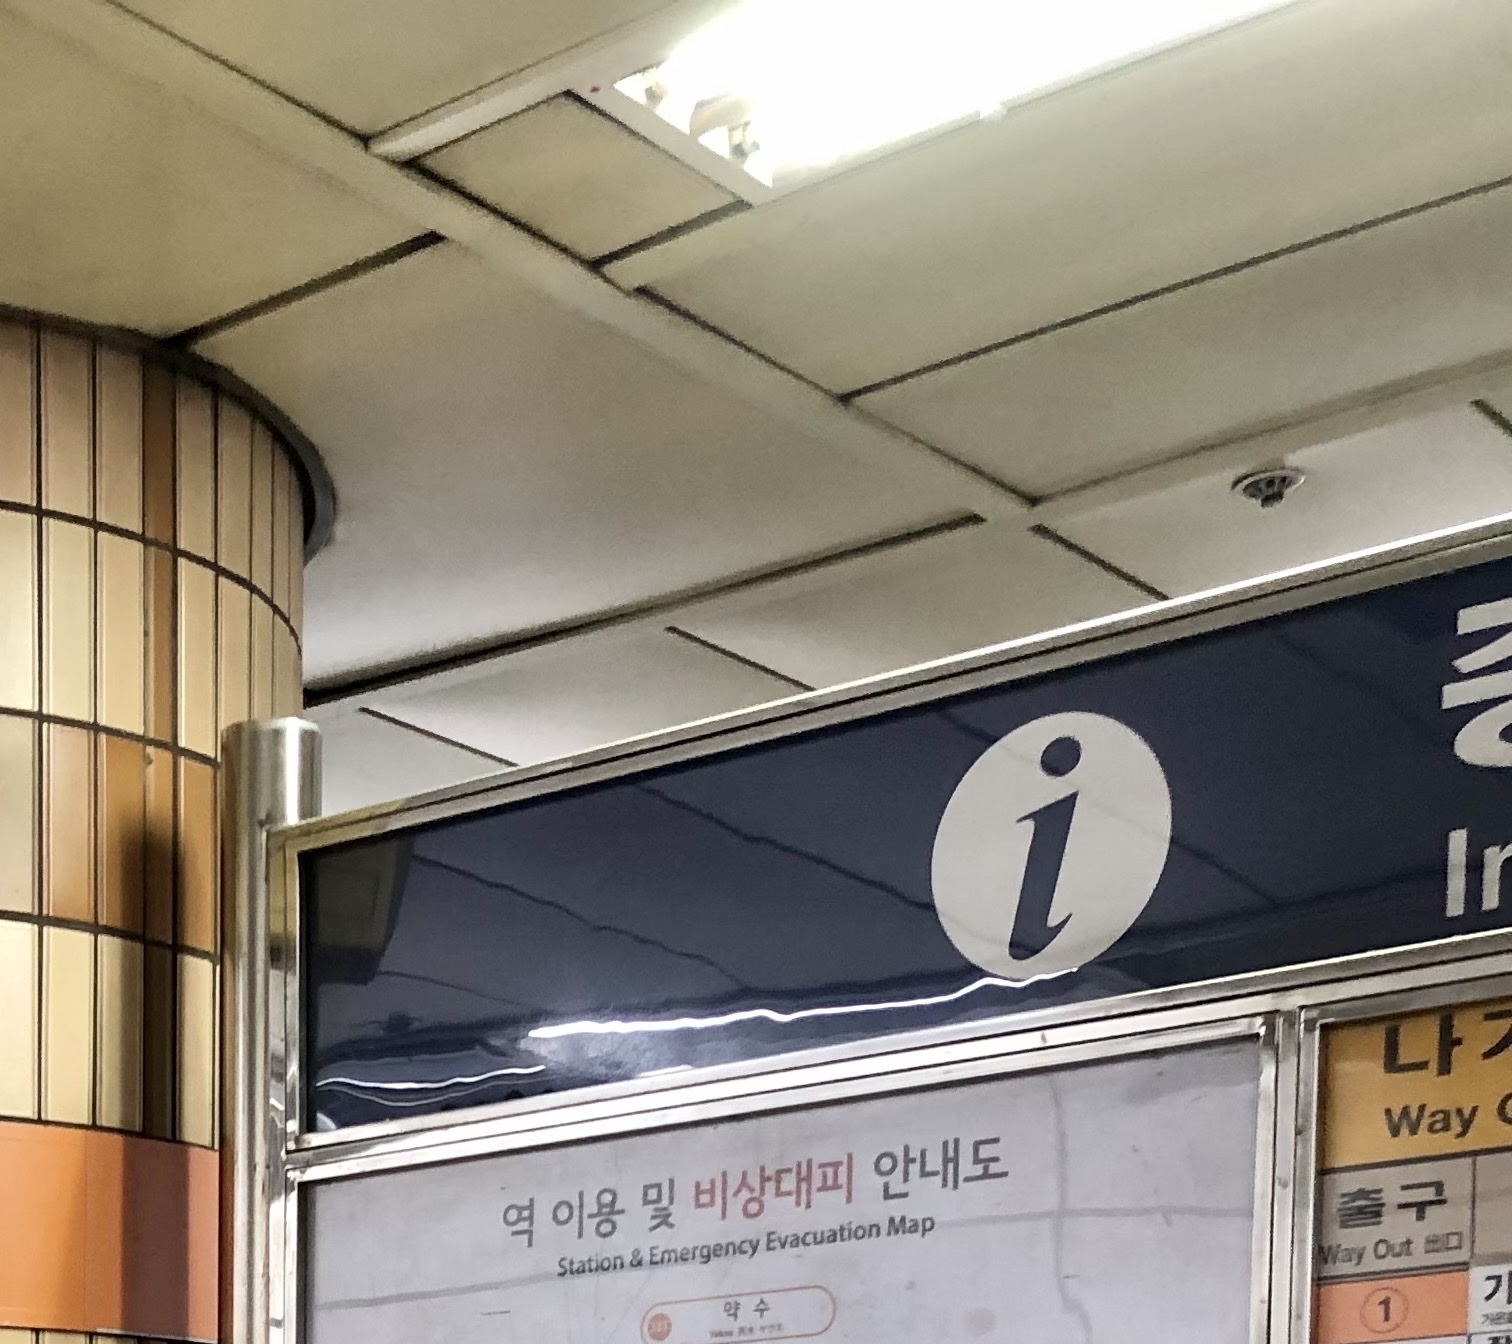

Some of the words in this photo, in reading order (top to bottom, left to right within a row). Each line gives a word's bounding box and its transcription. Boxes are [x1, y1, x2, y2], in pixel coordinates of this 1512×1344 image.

[1384, 1103, 1480, 1140] Way
[501, 1196, 536, 1248] 역
[552, 1186, 626, 1241] 이용
[641, 1177, 676, 1231] 및
[693, 1152, 855, 1221] 비상대피
[873, 1136, 1010, 1202] 안내도
[1337, 1180, 1448, 1229] 출구
[556, 1254, 625, 1279] Station
[630, 1248, 644, 1268] &
[648, 1236, 761, 1270] Emergency
[766, 1219, 882, 1255] Evacuation
[886, 1213, 937, 1242] Map
[1319, 1242, 1367, 1266] Way
[1373, 1237, 1414, 1260] Out
